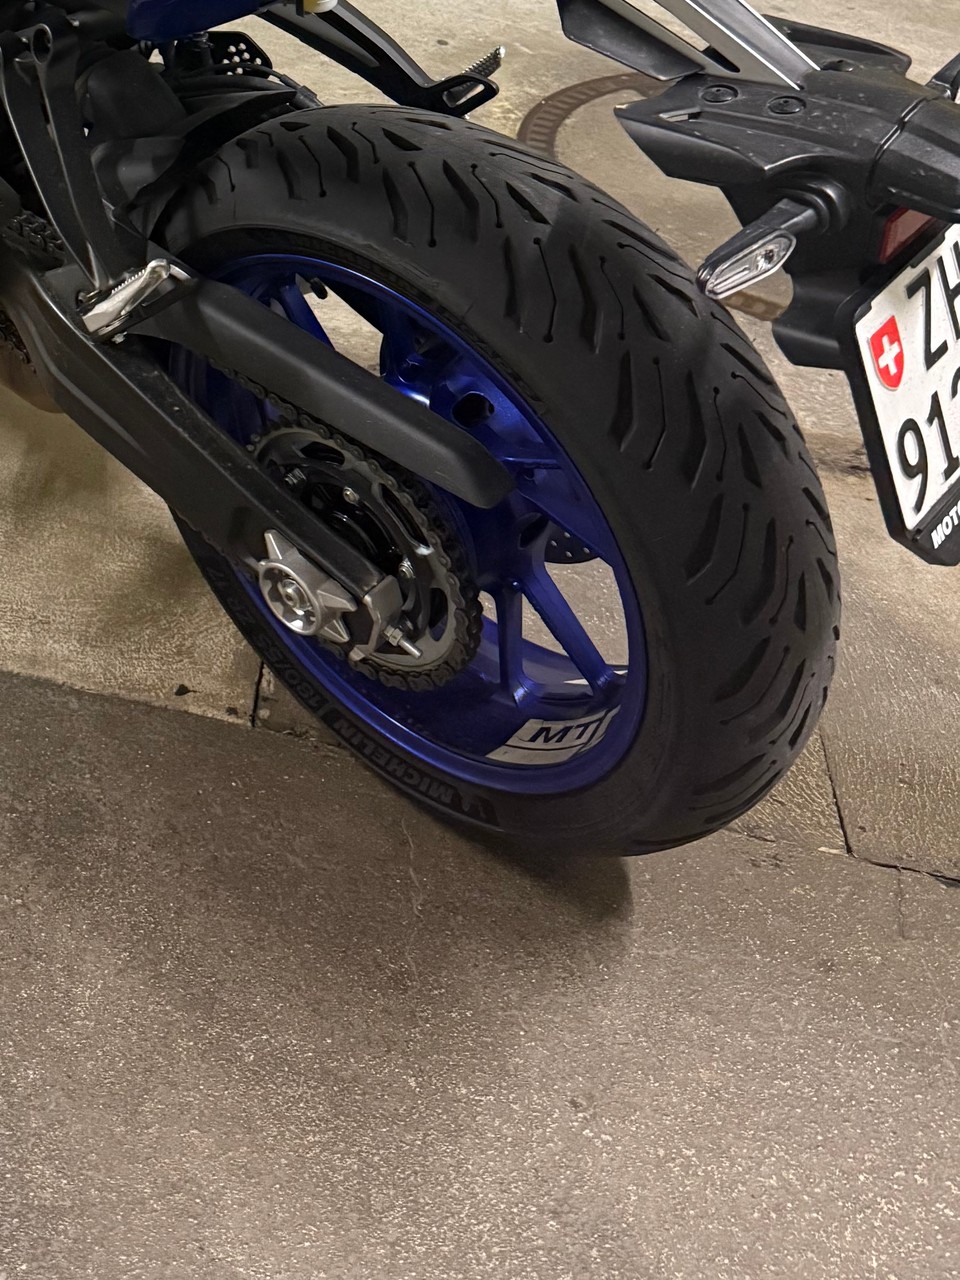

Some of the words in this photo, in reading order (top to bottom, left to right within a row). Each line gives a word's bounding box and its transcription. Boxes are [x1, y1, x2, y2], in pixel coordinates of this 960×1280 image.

[897, 367, 960, 516] 91
[333, 720, 457, 803] MICHELIN
[528, 717, 602, 744] MT
